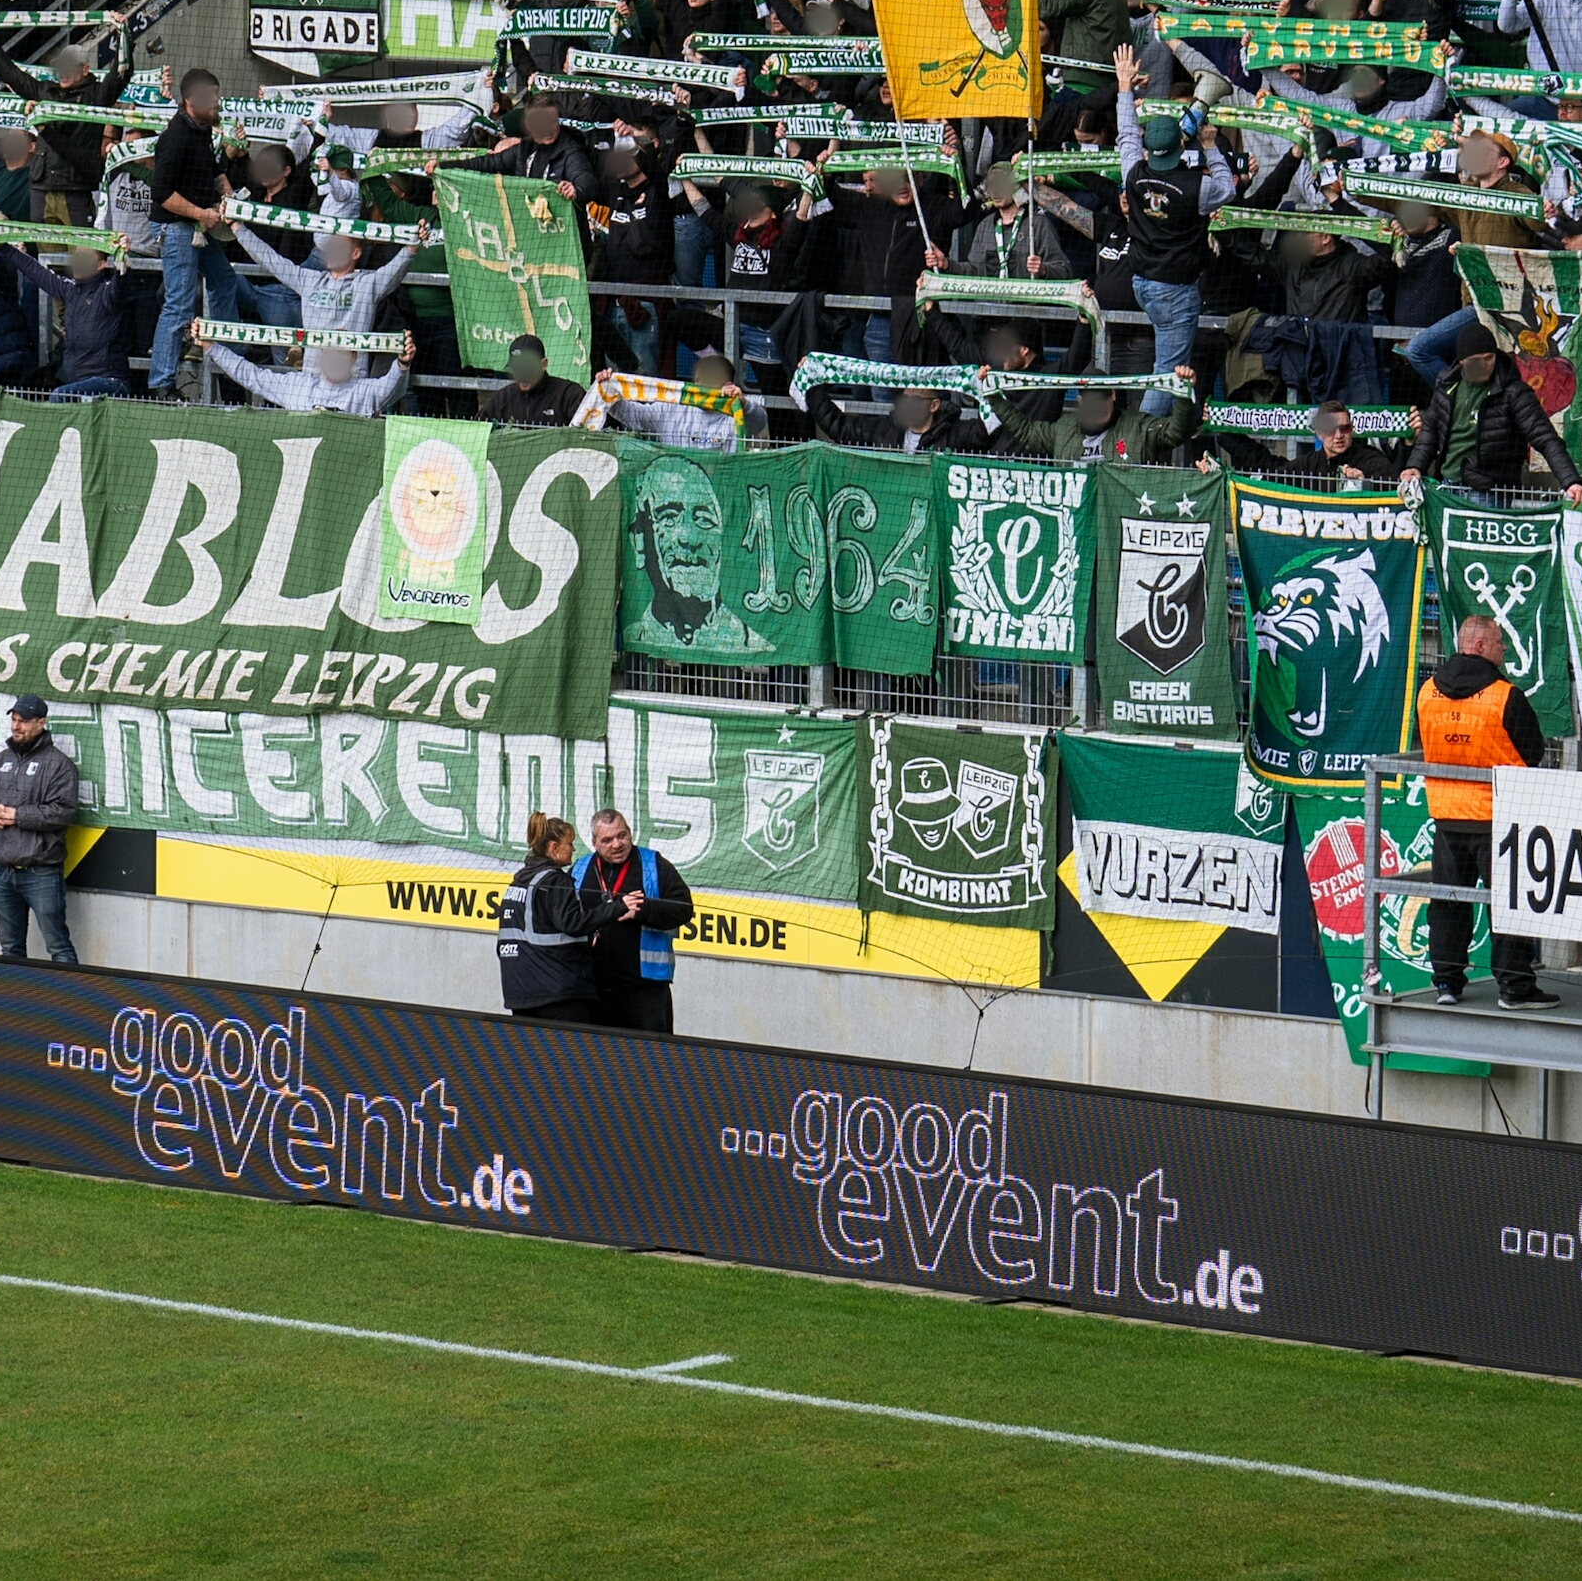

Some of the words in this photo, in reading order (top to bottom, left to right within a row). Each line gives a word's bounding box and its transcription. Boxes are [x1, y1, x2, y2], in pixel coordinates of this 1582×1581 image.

[251, 13, 377, 47] BRIGADE
[1451, 71, 1536, 94] CHEMIE
[224, 196, 420, 246] DIABLOS
[199, 322, 294, 347] ULTRAS
[306, 328, 406, 353] CHEMIE
[947, 464, 1087, 509] SEKTION
[1240, 497, 1416, 545] PARVENÜS
[1464, 519, 1539, 548] HBSG
[1123, 525, 1206, 550] LEIPZIG
[742, 483, 937, 626] 1964
[46, 641, 268, 703] CHEMIE
[277, 651, 498, 723] LEIPZIG
[1128, 680, 1192, 703] GREEN
[1112, 700, 1215, 727] BASTARDS
[1444, 733, 1472, 744] GÖTZ
[750, 757, 819, 778] LEIPZIG
[961, 767, 1014, 793] LEIPZIG
[898, 869, 1012, 907] KOMBINAT
